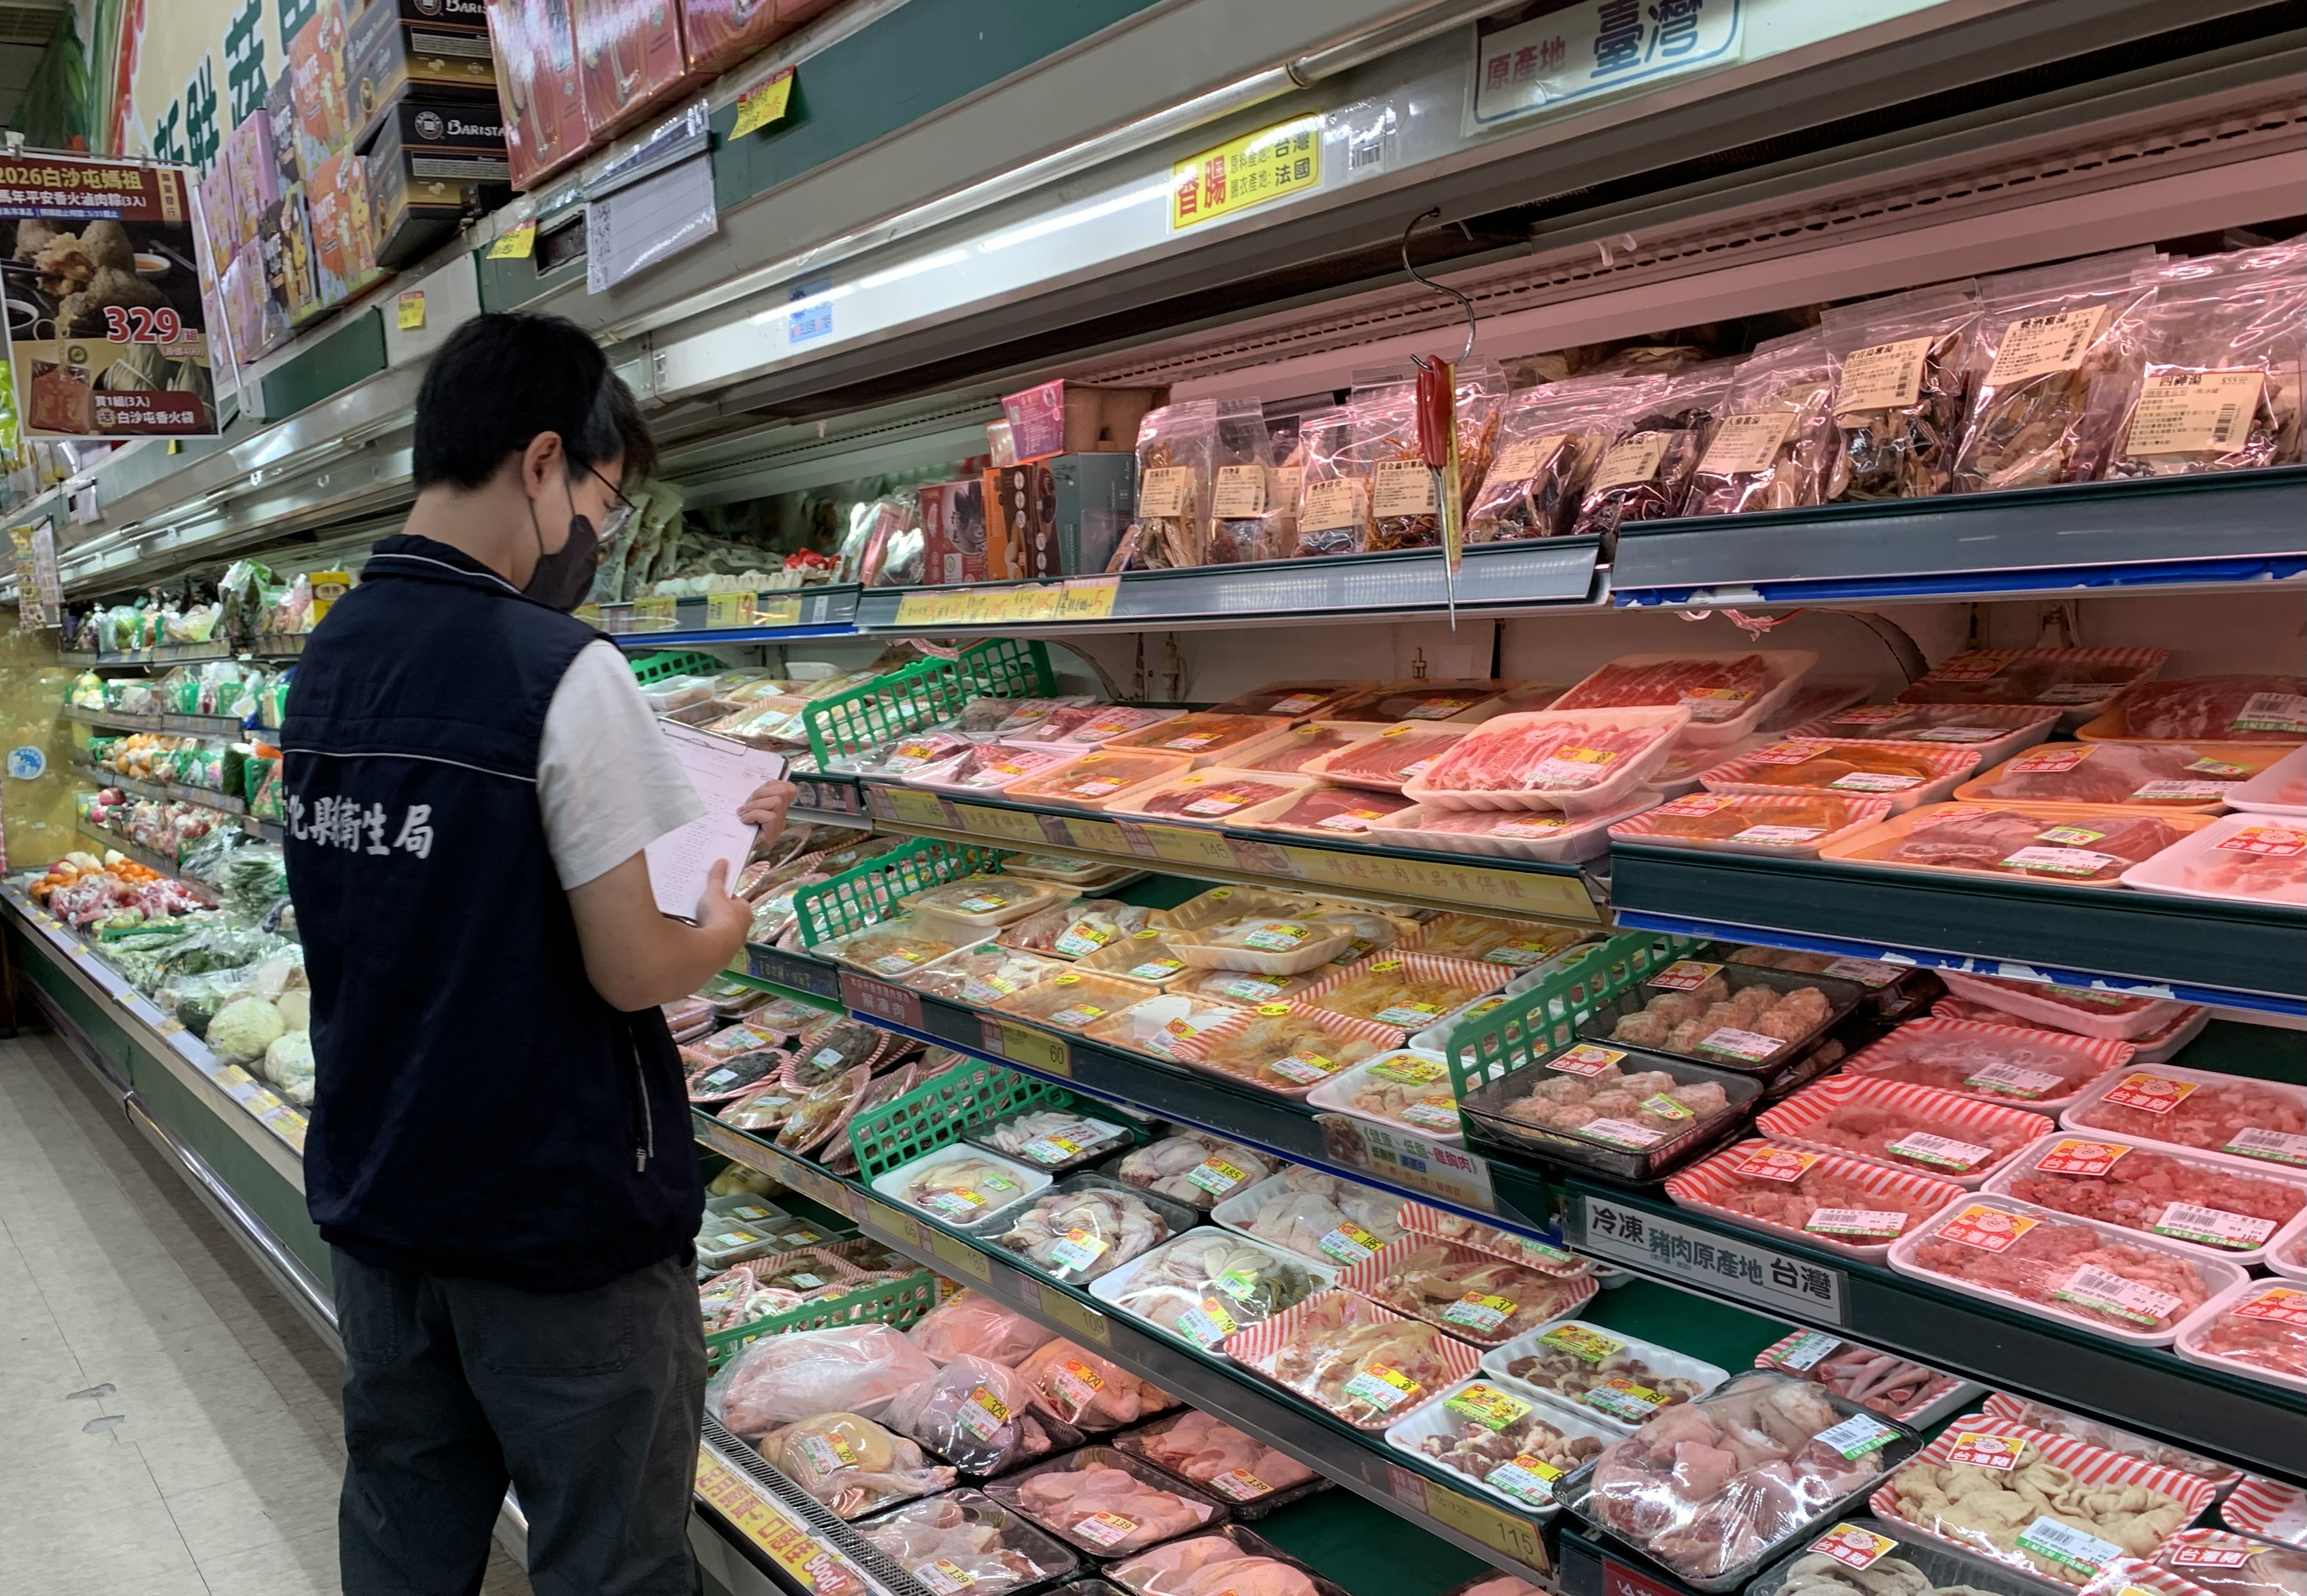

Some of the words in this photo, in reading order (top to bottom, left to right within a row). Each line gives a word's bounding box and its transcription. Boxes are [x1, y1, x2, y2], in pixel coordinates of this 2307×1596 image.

[1486, 35, 1566, 92] 原產地
[1275, 157, 1310, 187] 法國
[104, 306, 181, 343] 329
[117, 411, 195, 424] 白沙屯香火袋
[2075, 835, 2090, 843] 5
[1200, 842, 1229, 859] 145
[1653, 977, 1698, 988] 台灣豬
[1050, 1044, 1064, 1065] 60
[1554, 1058, 1598, 1074] 台灣豬
[2109, 1091, 2169, 1110] 台灣豬
[1666, 1109, 1679, 1118] 5
[1221, 1164, 1241, 1179] 185
[1741, 1163, 1797, 1179] 台灣豬
[2044, 1159, 2103, 1173] 台灣豬
[1360, 1234, 1382, 1251] 185
[1946, 1225, 2005, 1249] 台灣豬
[1592, 1204, 1644, 1244] 冷凍
[1648, 1227, 1764, 1287] 豬肉原產地
[1771, 1257, 1832, 1301] 台灣
[967, 1252, 985, 1273] 185
[1494, 1298, 1514, 1312] 37
[1082, 1310, 1104, 1334] 109
[1083, 1372, 1102, 1389] 329
[1396, 1379, 1413, 1391] 36
[987, 1400, 1007, 1420] 329
[837, 1448, 854, 1463] 329
[1953, 1452, 2009, 1467] 台灣豬
[1247, 1476, 1268, 1491] 139
[1111, 1518, 1132, 1531] 139
[758, 1517, 814, 1564] 口感佳
[1497, 1522, 1534, 1556] 115
[1814, 1541, 1870, 1565] 台灣豬
[2179, 1549, 2244, 1564] 台灣豬
[803, 1546, 846, 1595] good!
[948, 1569, 971, 1584] 139
